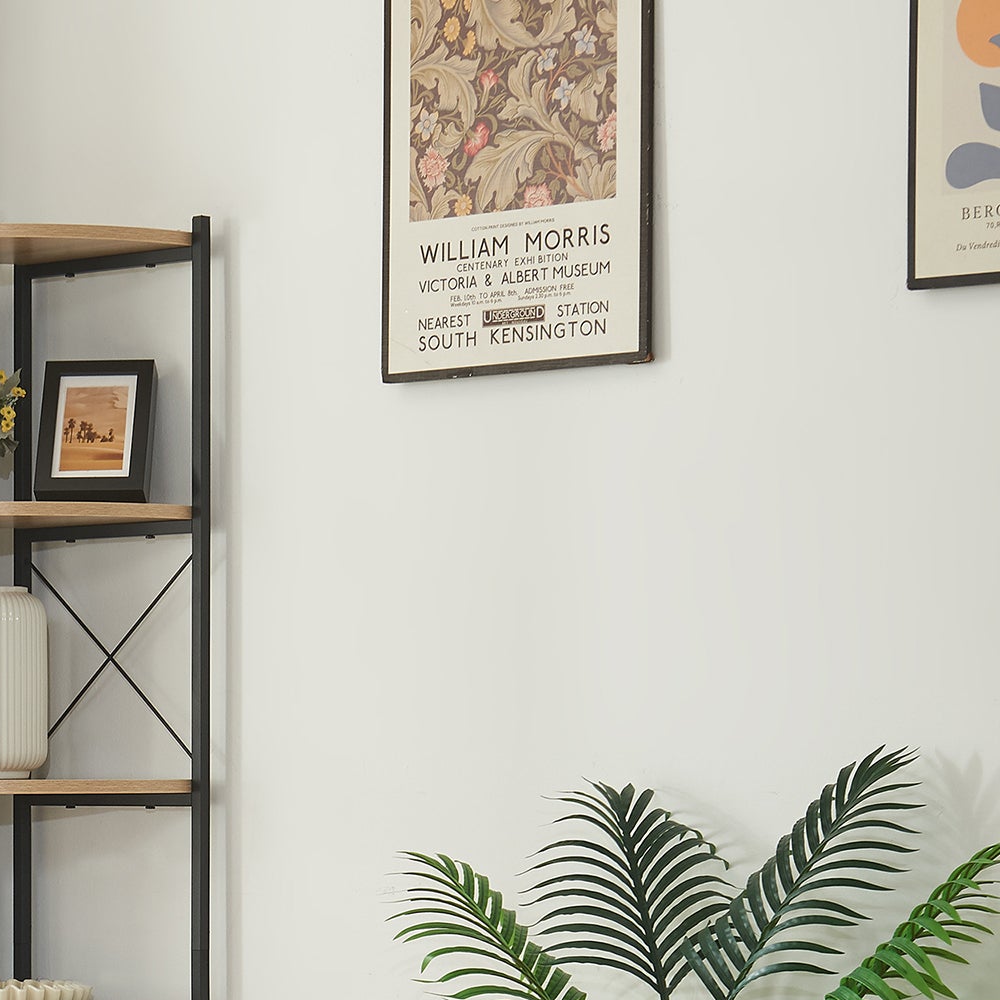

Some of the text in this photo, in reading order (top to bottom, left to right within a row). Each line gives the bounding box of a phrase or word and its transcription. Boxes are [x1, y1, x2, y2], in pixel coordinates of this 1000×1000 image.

[420, 224, 610, 264] WILLIAM MORRIS
[419, 261, 611, 294] VICTORIA & ALBERT MUSEUM
[456, 258, 509, 272] CENTENARY
[524, 285, 557, 294] ADMISSION
[418, 300, 610, 331] NEAREST UNDERGROUND STATION
[418, 318, 607, 351] SOUTH KENSINGTON
